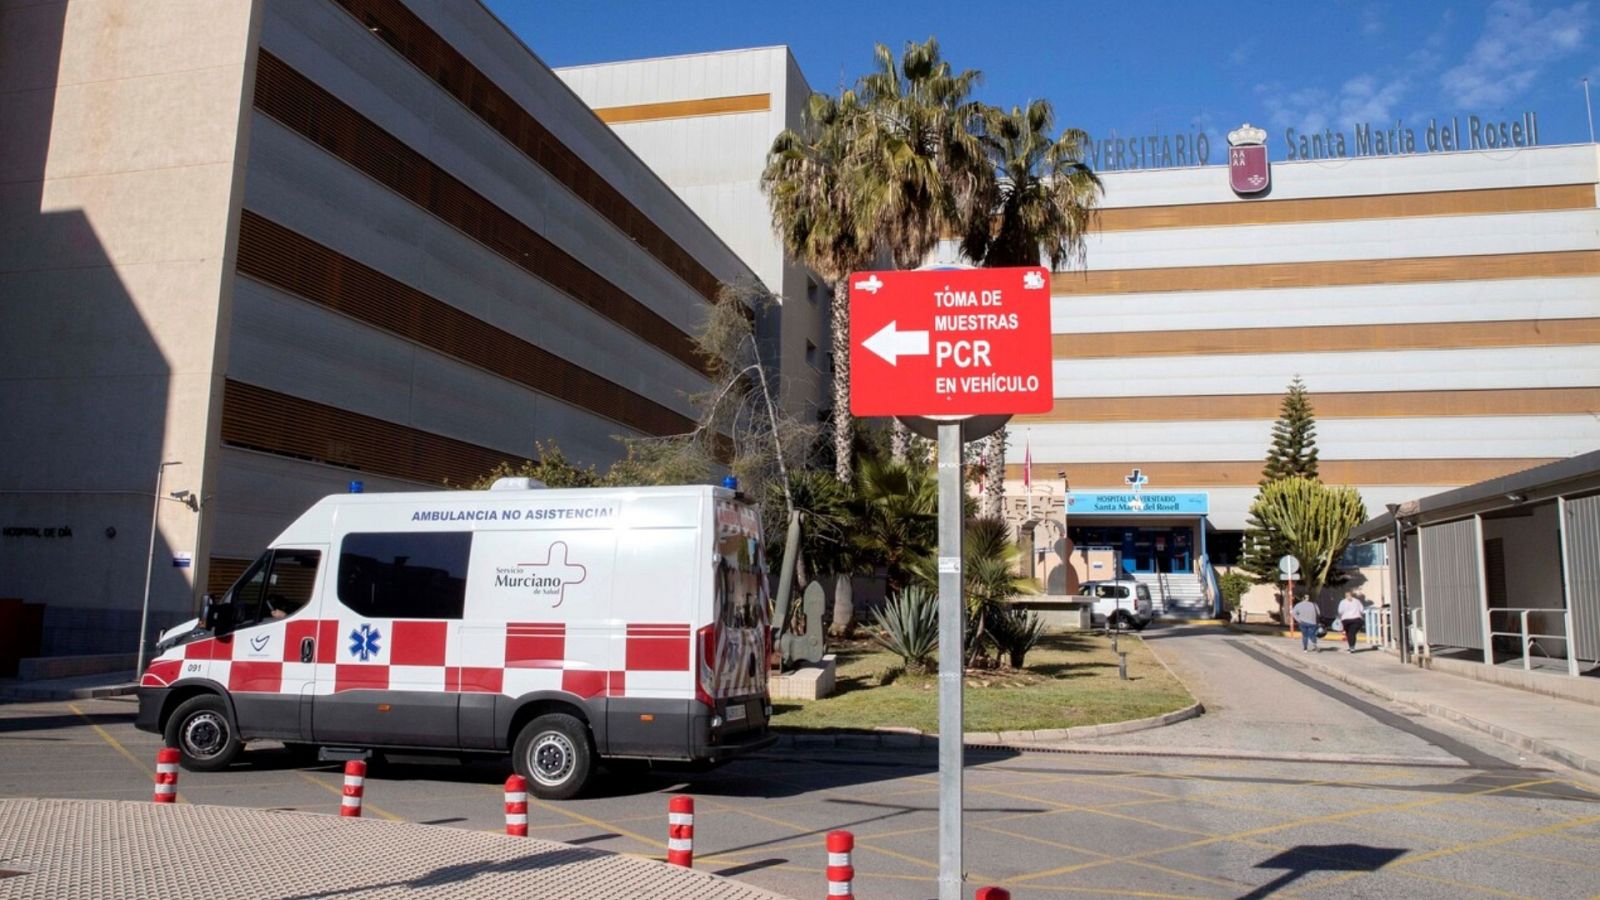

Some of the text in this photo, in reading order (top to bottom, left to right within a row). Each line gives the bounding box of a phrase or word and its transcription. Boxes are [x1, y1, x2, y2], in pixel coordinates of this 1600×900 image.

[1087, 111, 1538, 171] VERSITARIO Santa María del Rosell
[981, 290, 1003, 306] DE
[934, 313, 1019, 331] MUESTRAS
[935, 340, 992, 368] PCR
[935, 372, 1040, 394] EN VEHÍCULO
[1096, 495, 1125, 503] HOSPITAL
[1094, 503, 1117, 511] Santa
[1143, 503, 1155, 511] del
[1156, 503, 1180, 511] Rosell
[411, 510, 498, 522] AMBULANCIA
[501, 509, 521, 521] NO
[43, 527, 56, 538] DE
[496, 567, 524, 575] Servicio
[494, 574, 561, 588] Murciano
[187, 664, 202, 672] 091
